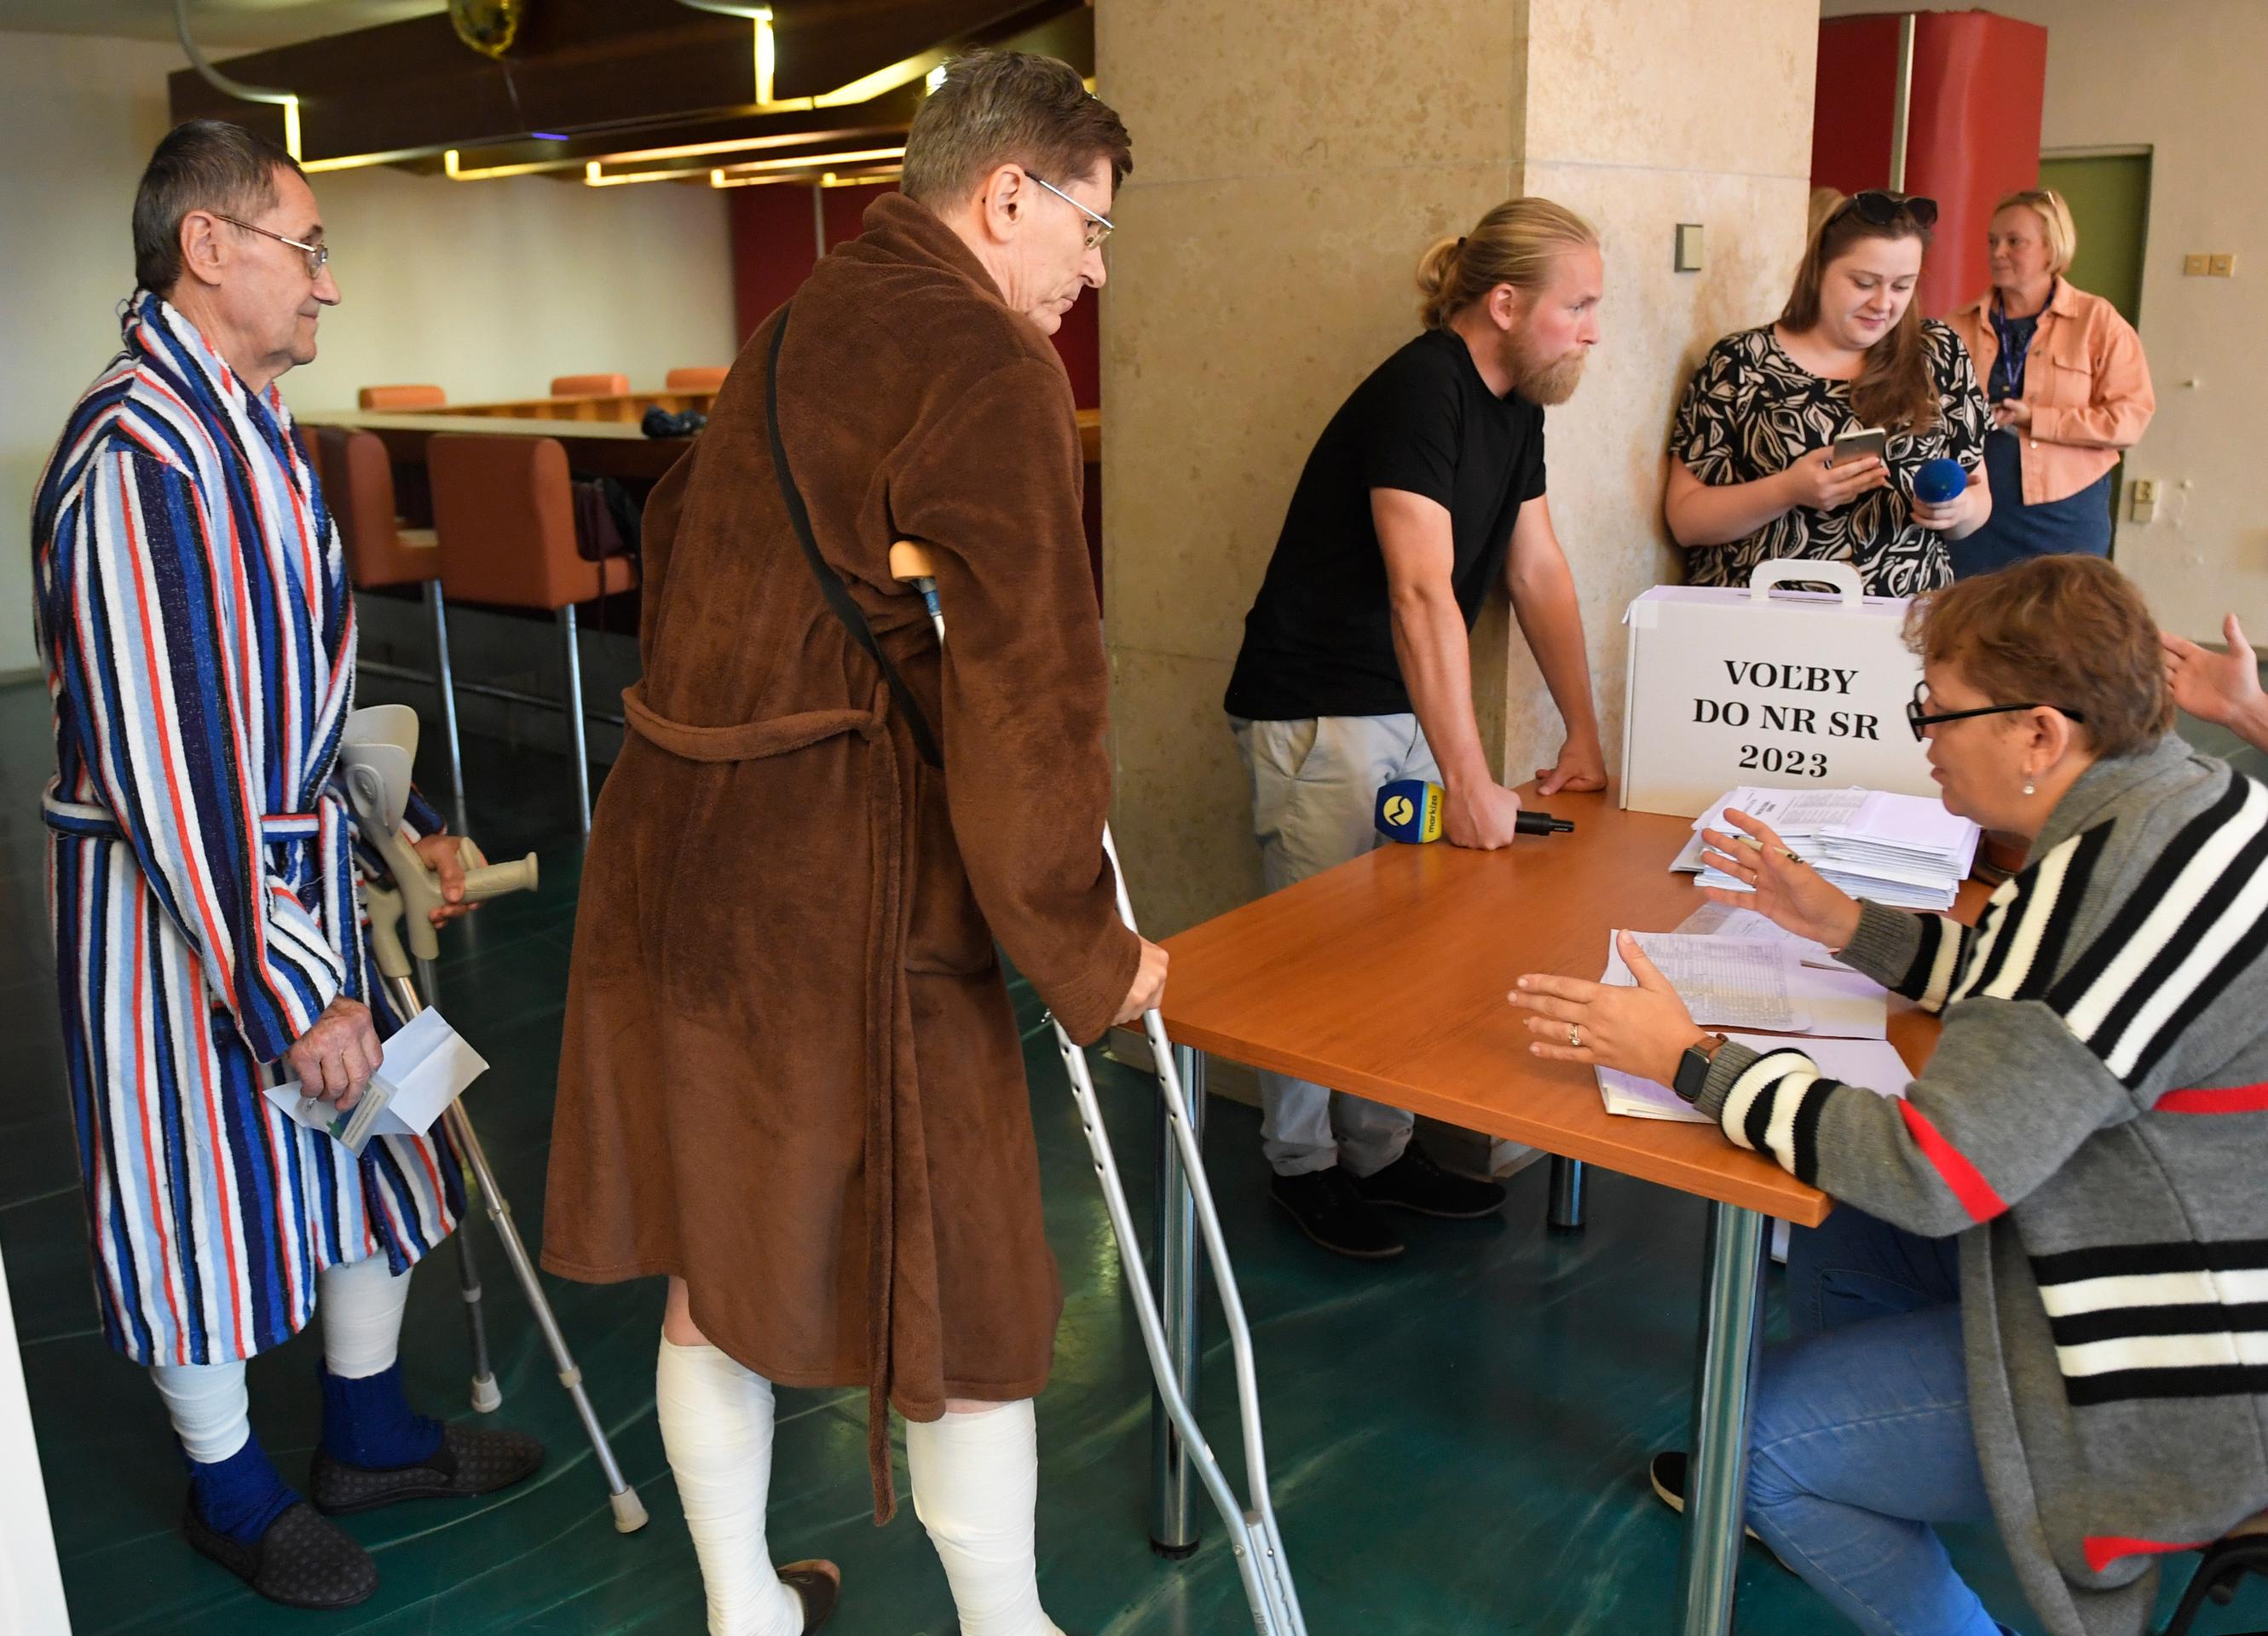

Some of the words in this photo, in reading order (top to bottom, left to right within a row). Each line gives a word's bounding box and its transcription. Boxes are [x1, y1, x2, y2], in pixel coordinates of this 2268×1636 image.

[1723, 660, 1860, 695] VOĽBY
[1693, 699, 1750, 727] DO
[1760, 705, 1816, 734] NR
[1828, 711, 1880, 741] SR
[1739, 745, 1827, 778] 2023
[1428, 795, 1438, 832] markiza
